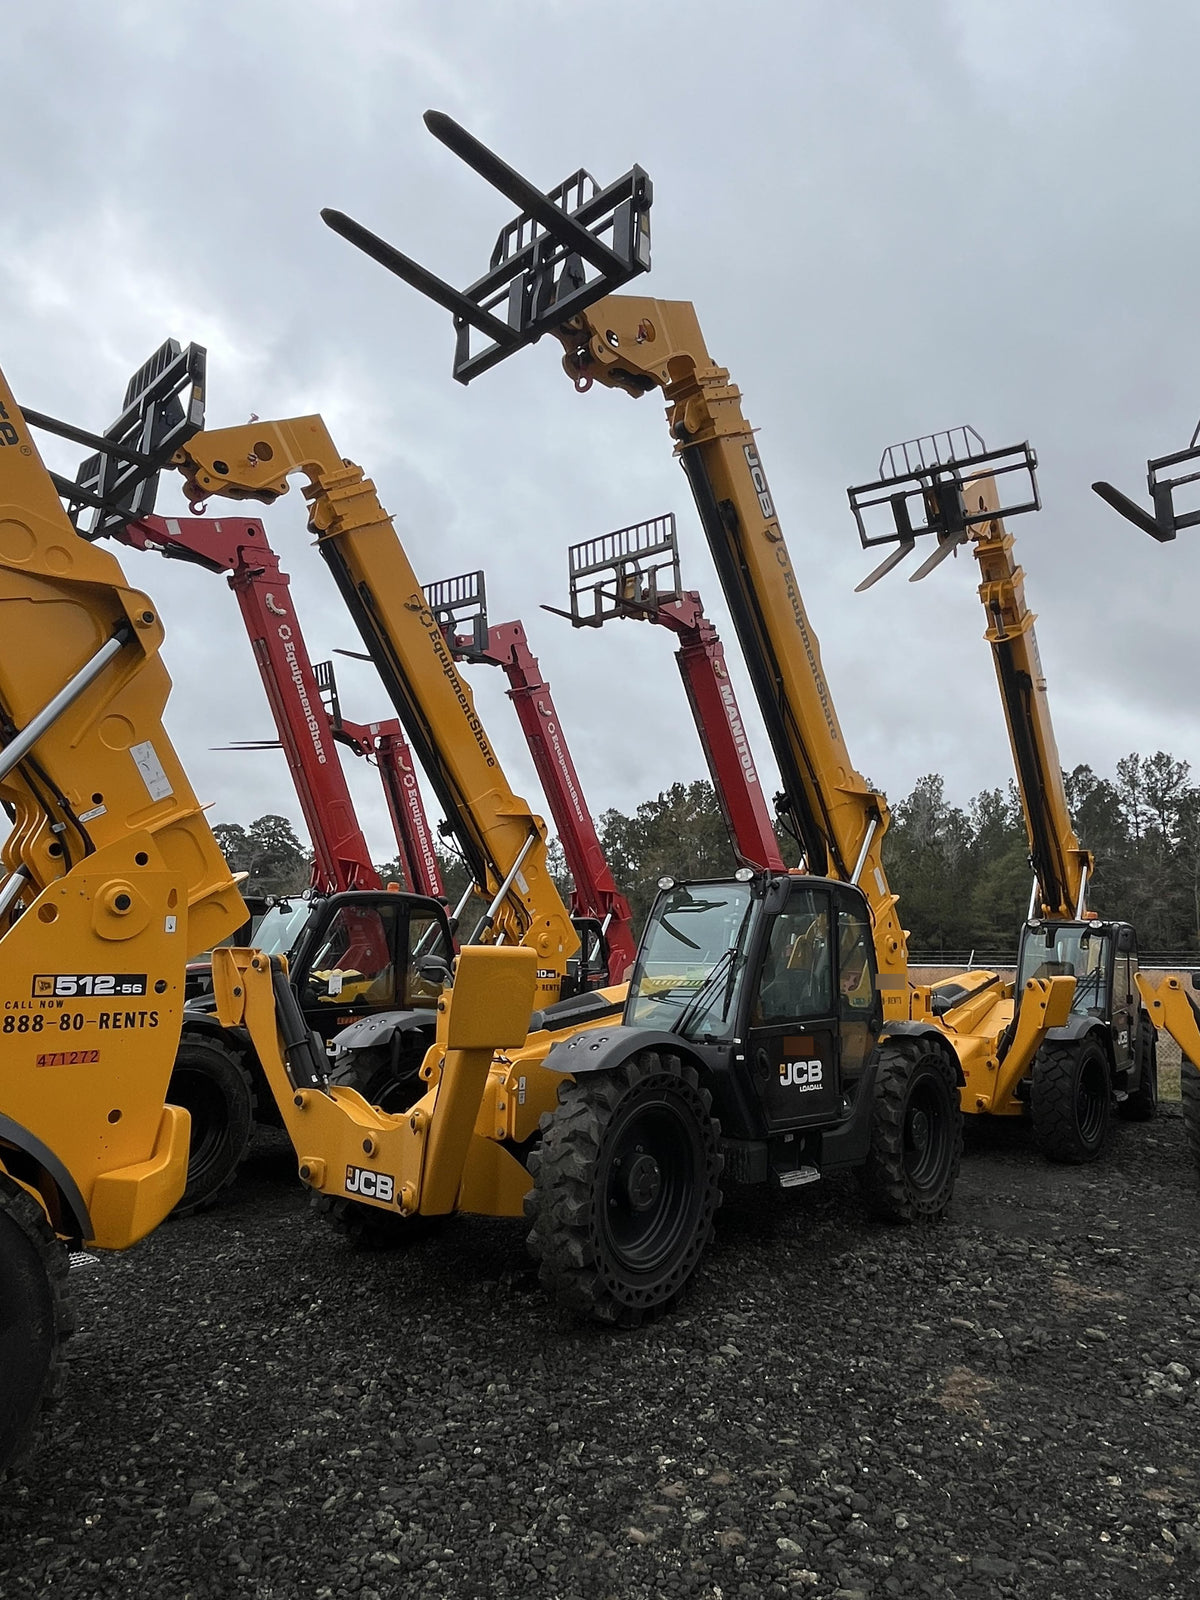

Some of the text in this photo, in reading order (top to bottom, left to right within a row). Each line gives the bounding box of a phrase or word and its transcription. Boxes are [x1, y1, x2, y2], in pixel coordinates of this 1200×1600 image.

[744, 446, 773, 518] JCB
[783, 571, 838, 741] EquipmentShare
[284, 641, 327, 765] EquipmentShare
[429, 630, 495, 768] EquipmentShare
[720, 684, 757, 783] MANITOU
[552, 734, 585, 823] EquipmentShare
[408, 788, 440, 895] EquipmentShare
[4, 1000, 65, 1010] CALL NOW
[55, 975, 143, 995] 512-56
[2, 1010, 160, 1034] 888-80-RENTS
[36, 1050, 100, 1068] 471272
[779, 1060, 823, 1086] JCB
[799, 1083, 824, 1093] LOADALL
[346, 1168, 393, 1201] JCB
